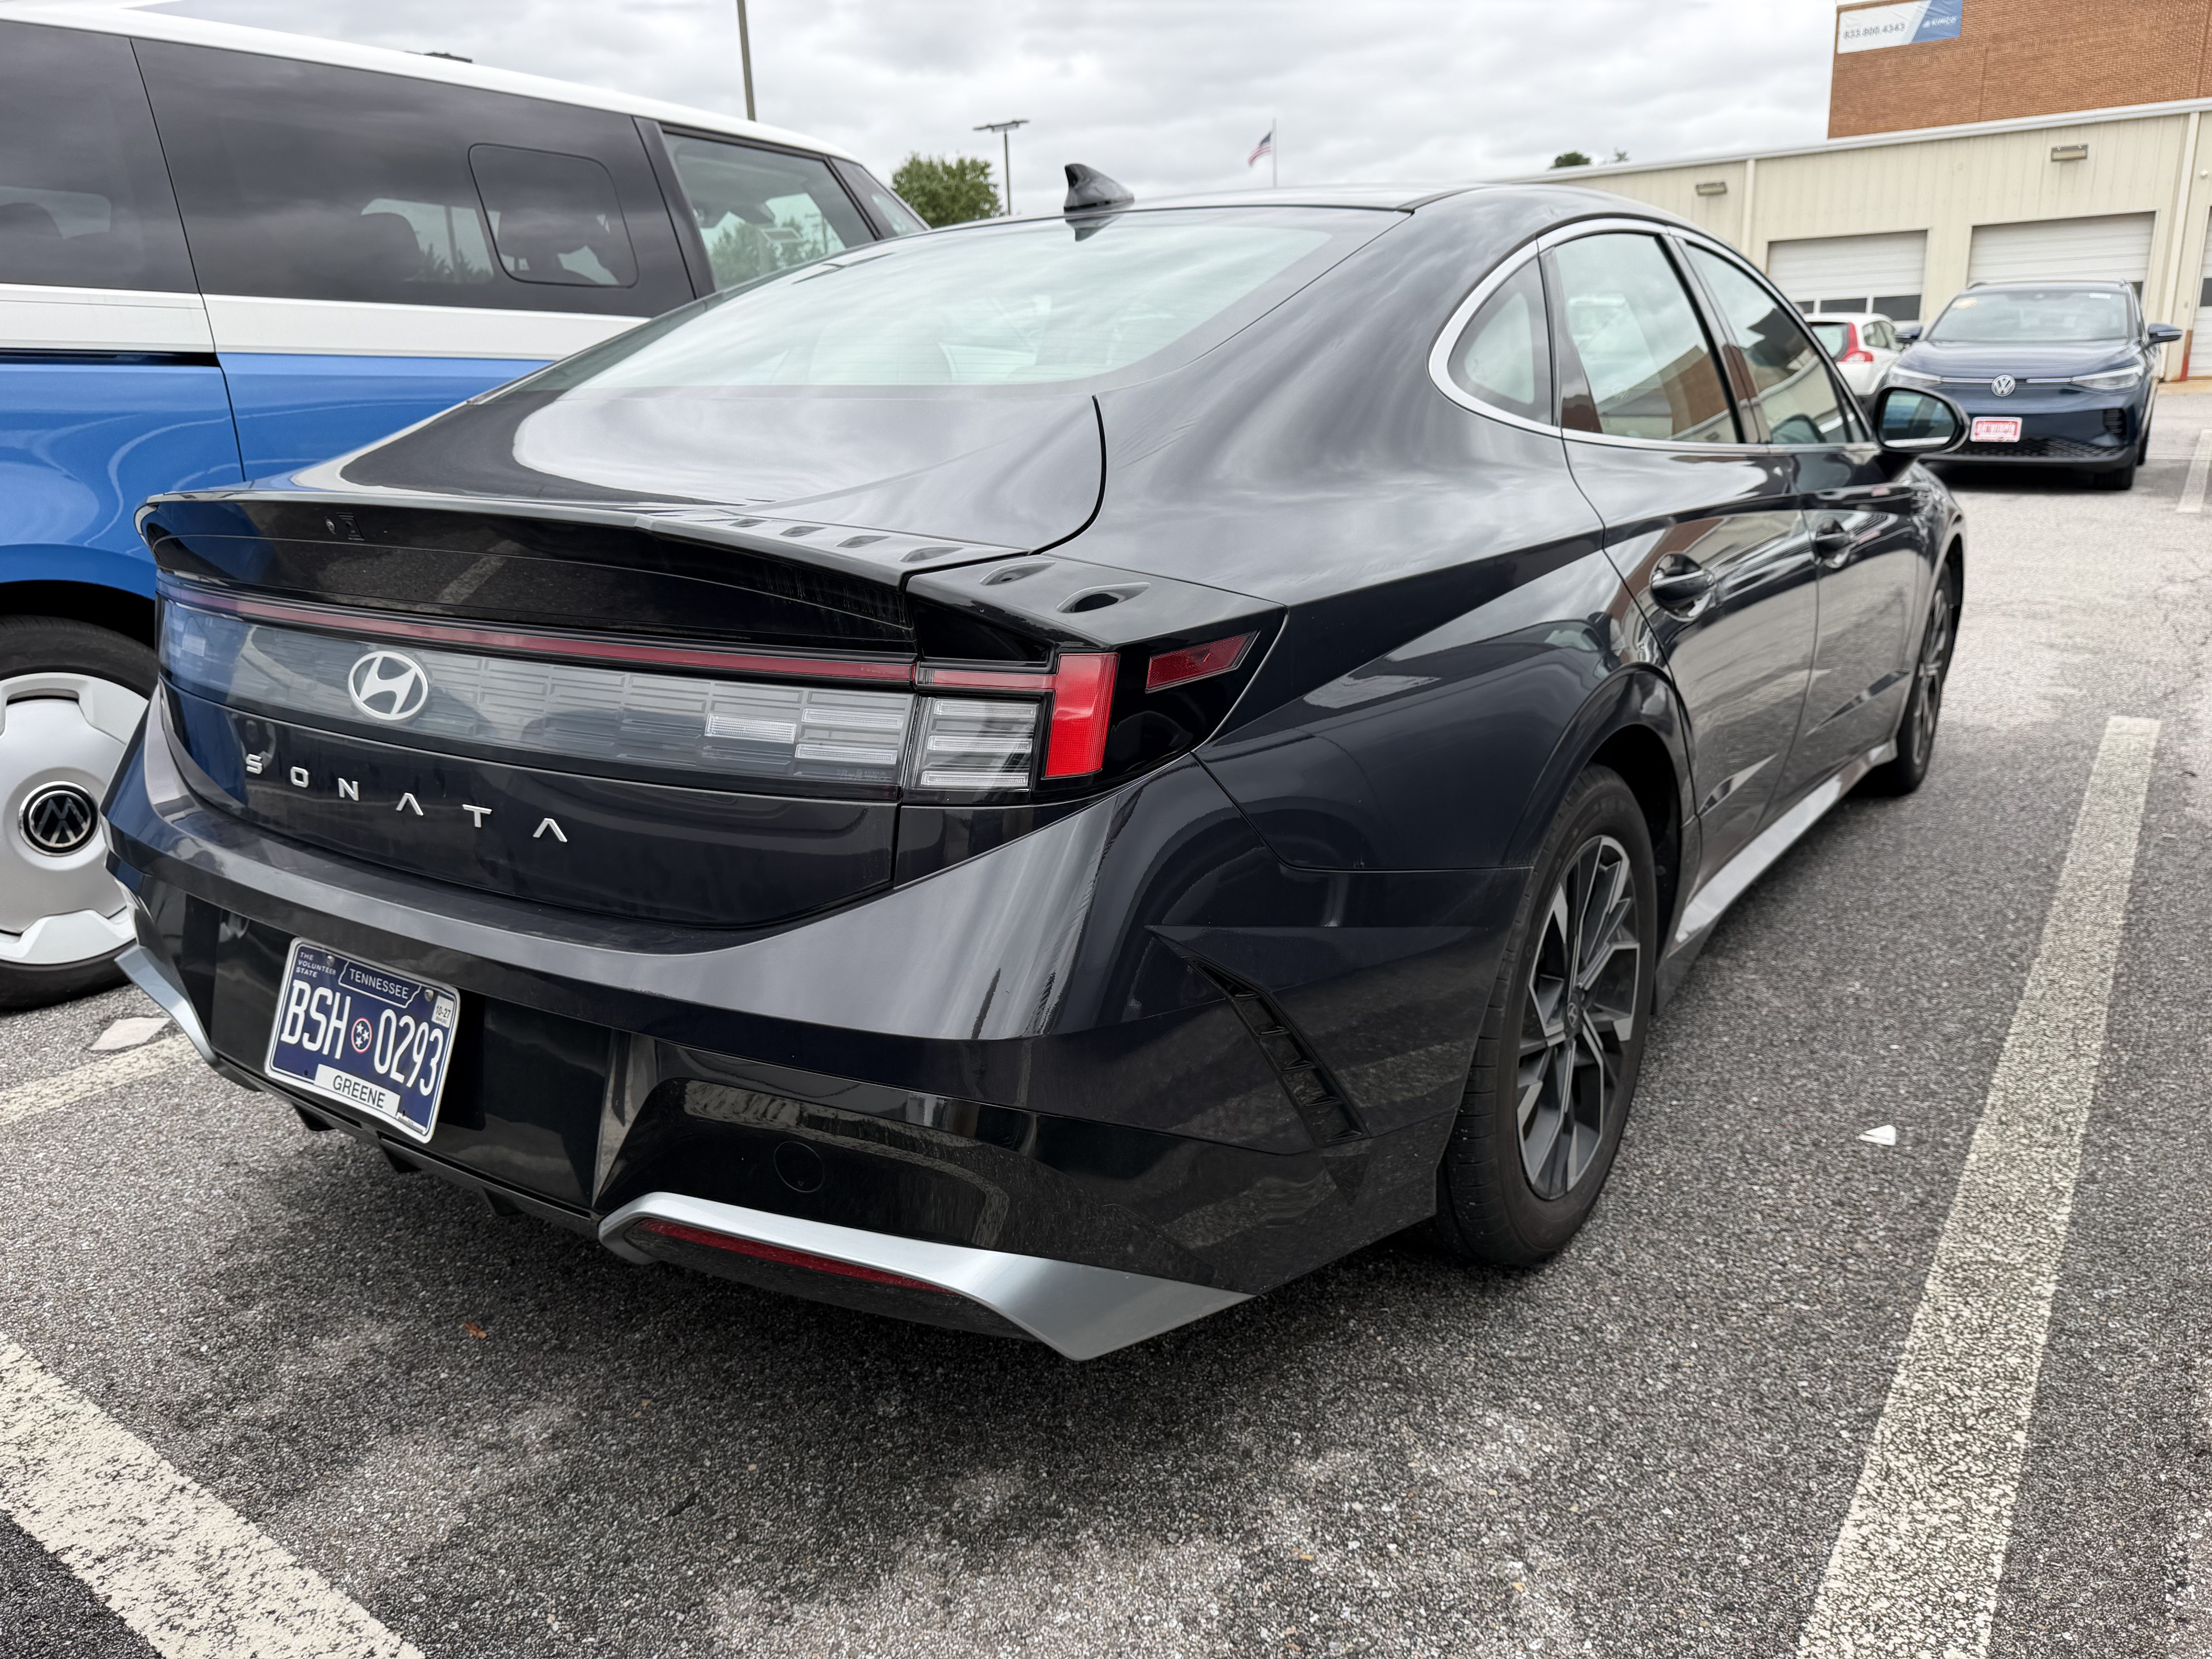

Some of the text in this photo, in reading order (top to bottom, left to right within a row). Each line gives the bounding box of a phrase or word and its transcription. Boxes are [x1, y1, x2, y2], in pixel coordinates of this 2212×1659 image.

[245, 754, 568, 843] SONATA
[298, 959, 336, 975] VOLUNTEER
[301, 952, 314, 961] THE
[296, 967, 318, 978] STATE
[350, 968, 409, 1000] TENNESSEE
[436, 1005, 451, 1019] 10-27
[280, 979, 443, 1096] BSH 0293
[333, 1075, 386, 1109] GREENE
